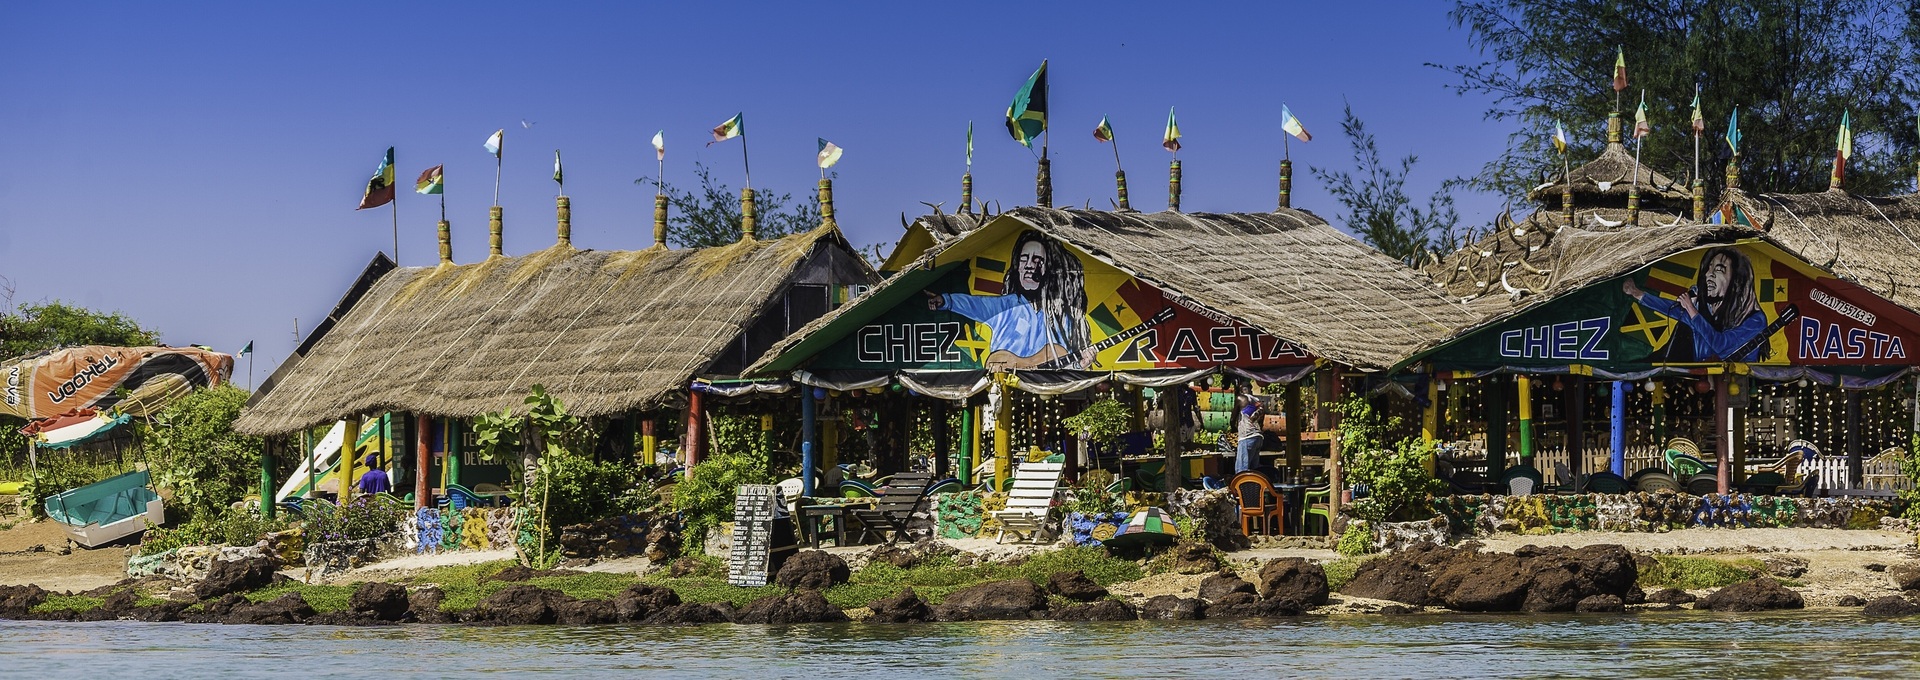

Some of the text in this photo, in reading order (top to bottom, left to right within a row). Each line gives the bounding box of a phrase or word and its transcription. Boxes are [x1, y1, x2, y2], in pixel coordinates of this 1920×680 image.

[857, 322, 1308, 364] CHEZ RASTA
[1500, 315, 1906, 360] CHEZ RASTA
